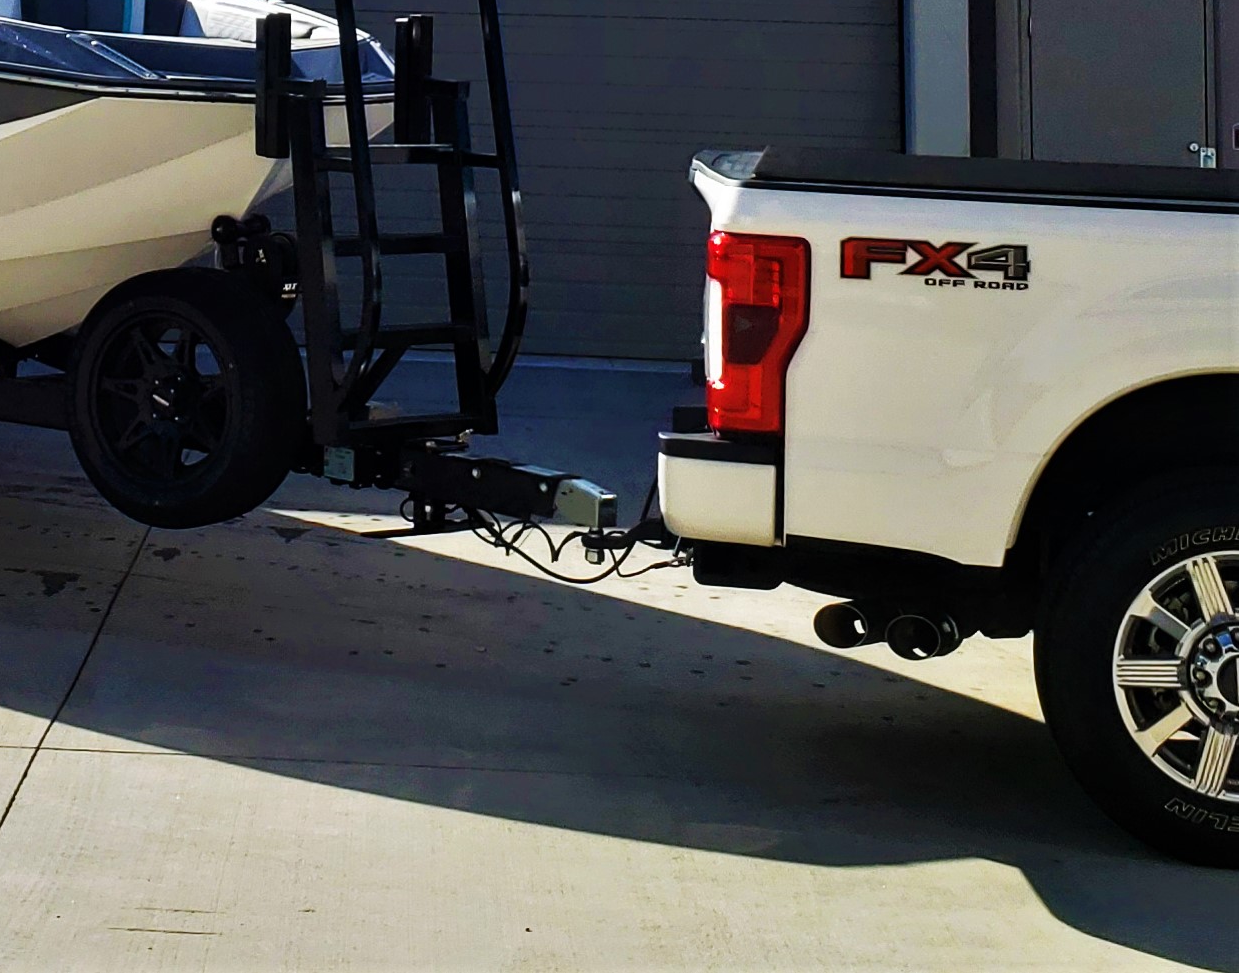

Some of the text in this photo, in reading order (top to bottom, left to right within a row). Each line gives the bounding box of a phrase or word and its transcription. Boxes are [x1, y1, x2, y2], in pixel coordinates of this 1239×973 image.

[840, 236, 1031, 281] FX4
[924, 278, 1029, 290] OFF ROAD
[1149, 526, 1239, 566] MICH
